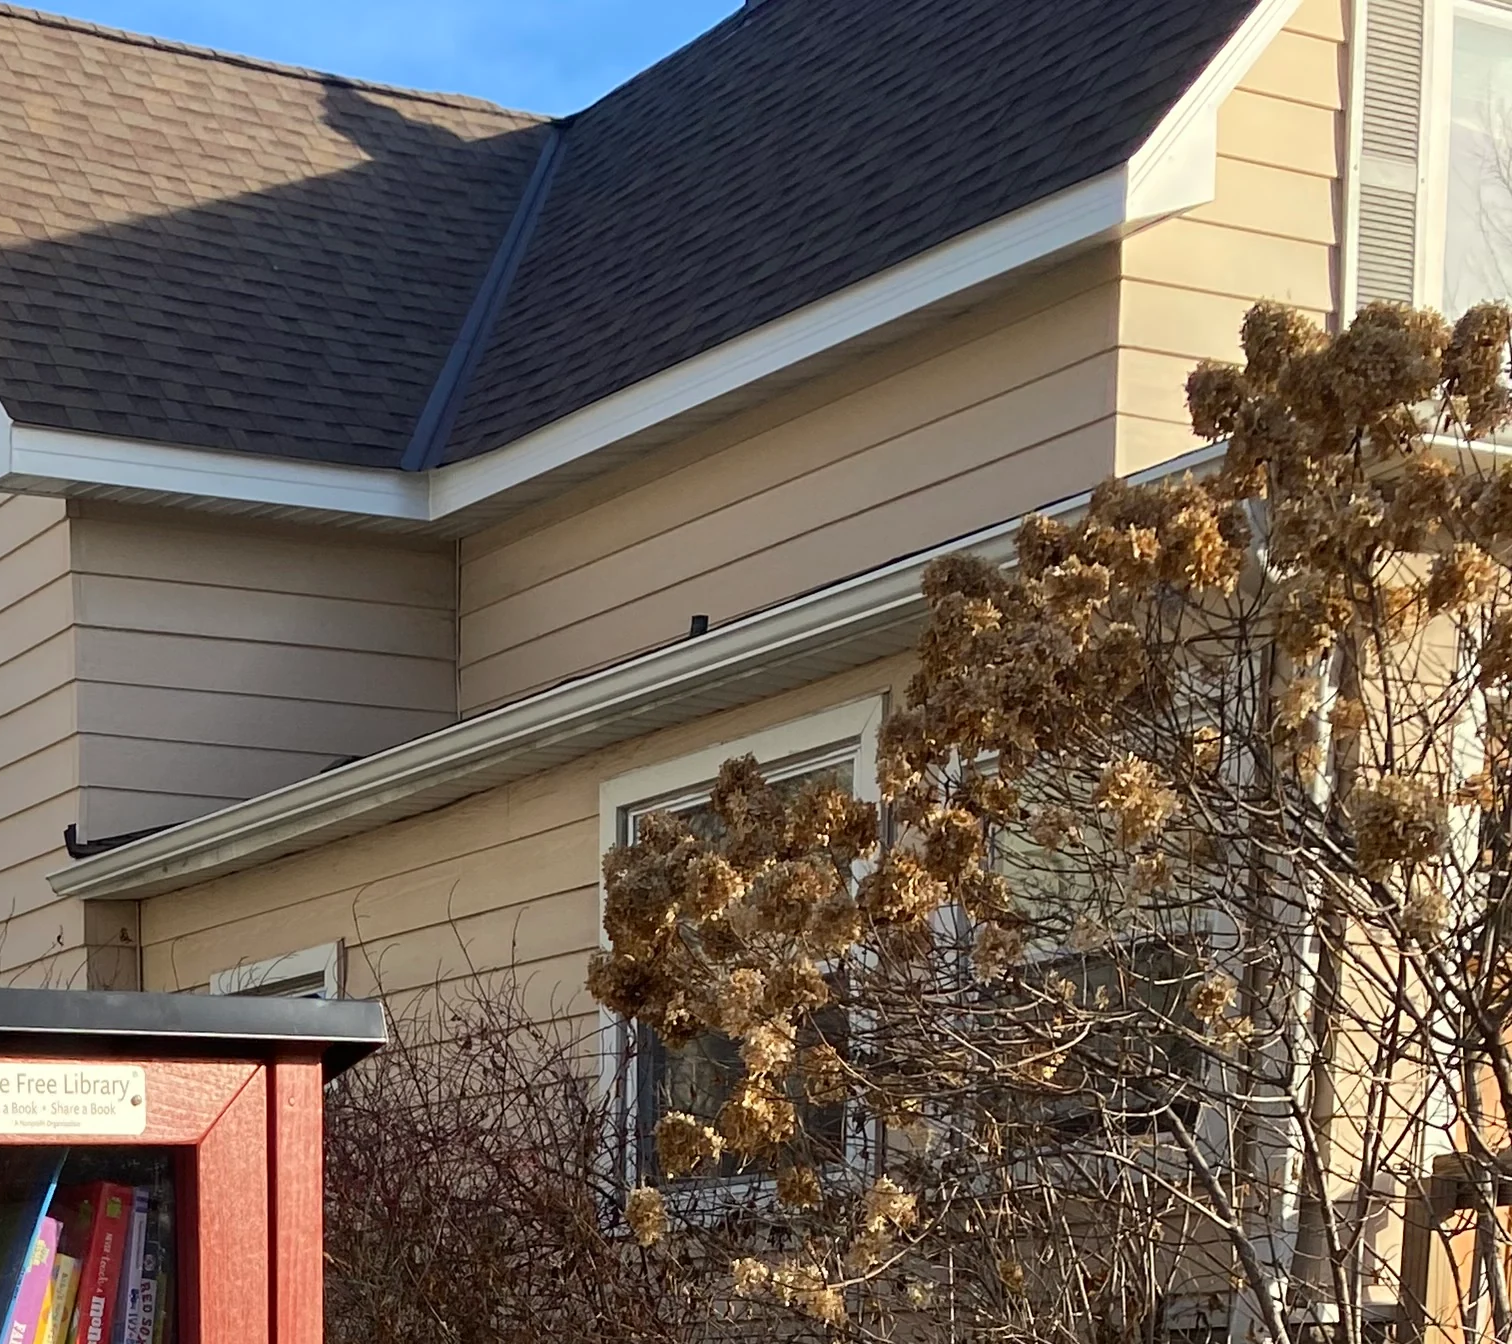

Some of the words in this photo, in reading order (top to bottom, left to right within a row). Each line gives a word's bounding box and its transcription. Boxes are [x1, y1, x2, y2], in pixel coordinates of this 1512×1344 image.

[17, 1073, 57, 1094] Free
[64, 1072, 130, 1102] Library
[3, 1105, 9, 1114] a
[11, 1101, 38, 1114] Book
[50, 1101, 79, 1115] Share
[82, 1105, 87, 1115] a
[90, 1102, 116, 1115] Book
[140, 1282, 153, 1313] RED
